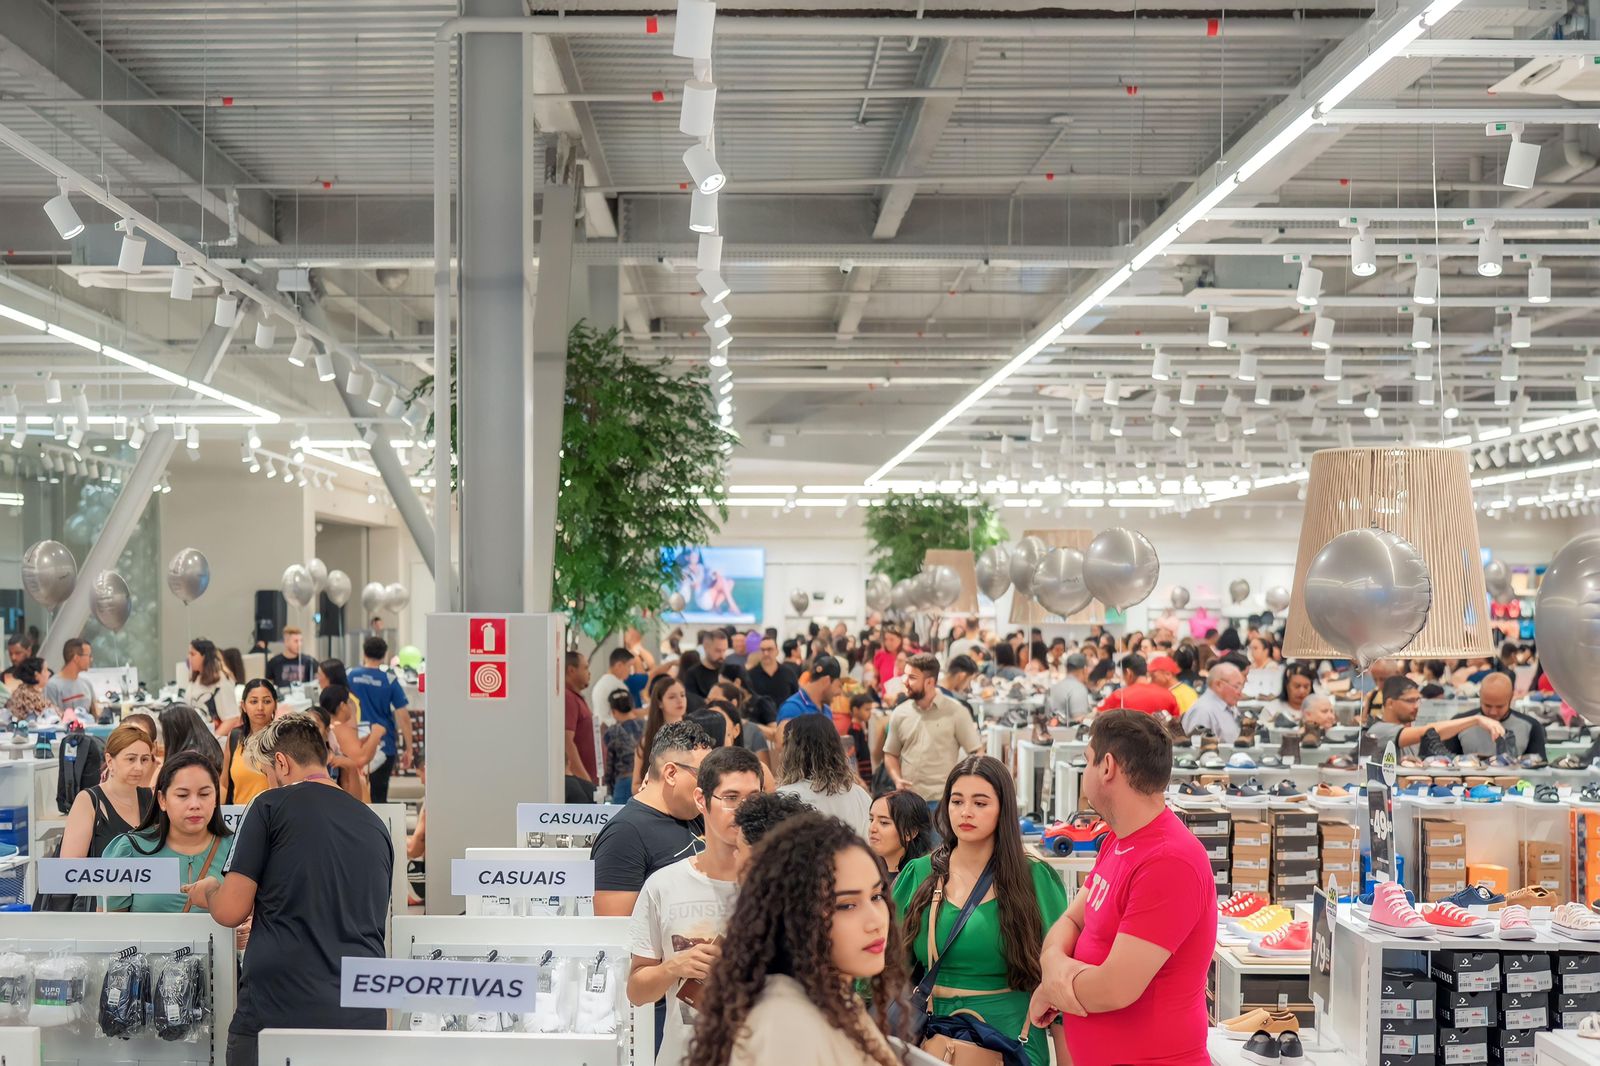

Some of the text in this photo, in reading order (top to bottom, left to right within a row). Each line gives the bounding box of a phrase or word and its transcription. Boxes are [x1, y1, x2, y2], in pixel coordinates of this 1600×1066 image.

[539, 812, 609, 825] CASUAIS
[65, 868, 152, 883] CASUAIS
[478, 870, 566, 885] CASUAIS
[352, 974, 523, 998] ESPORTIVAS
